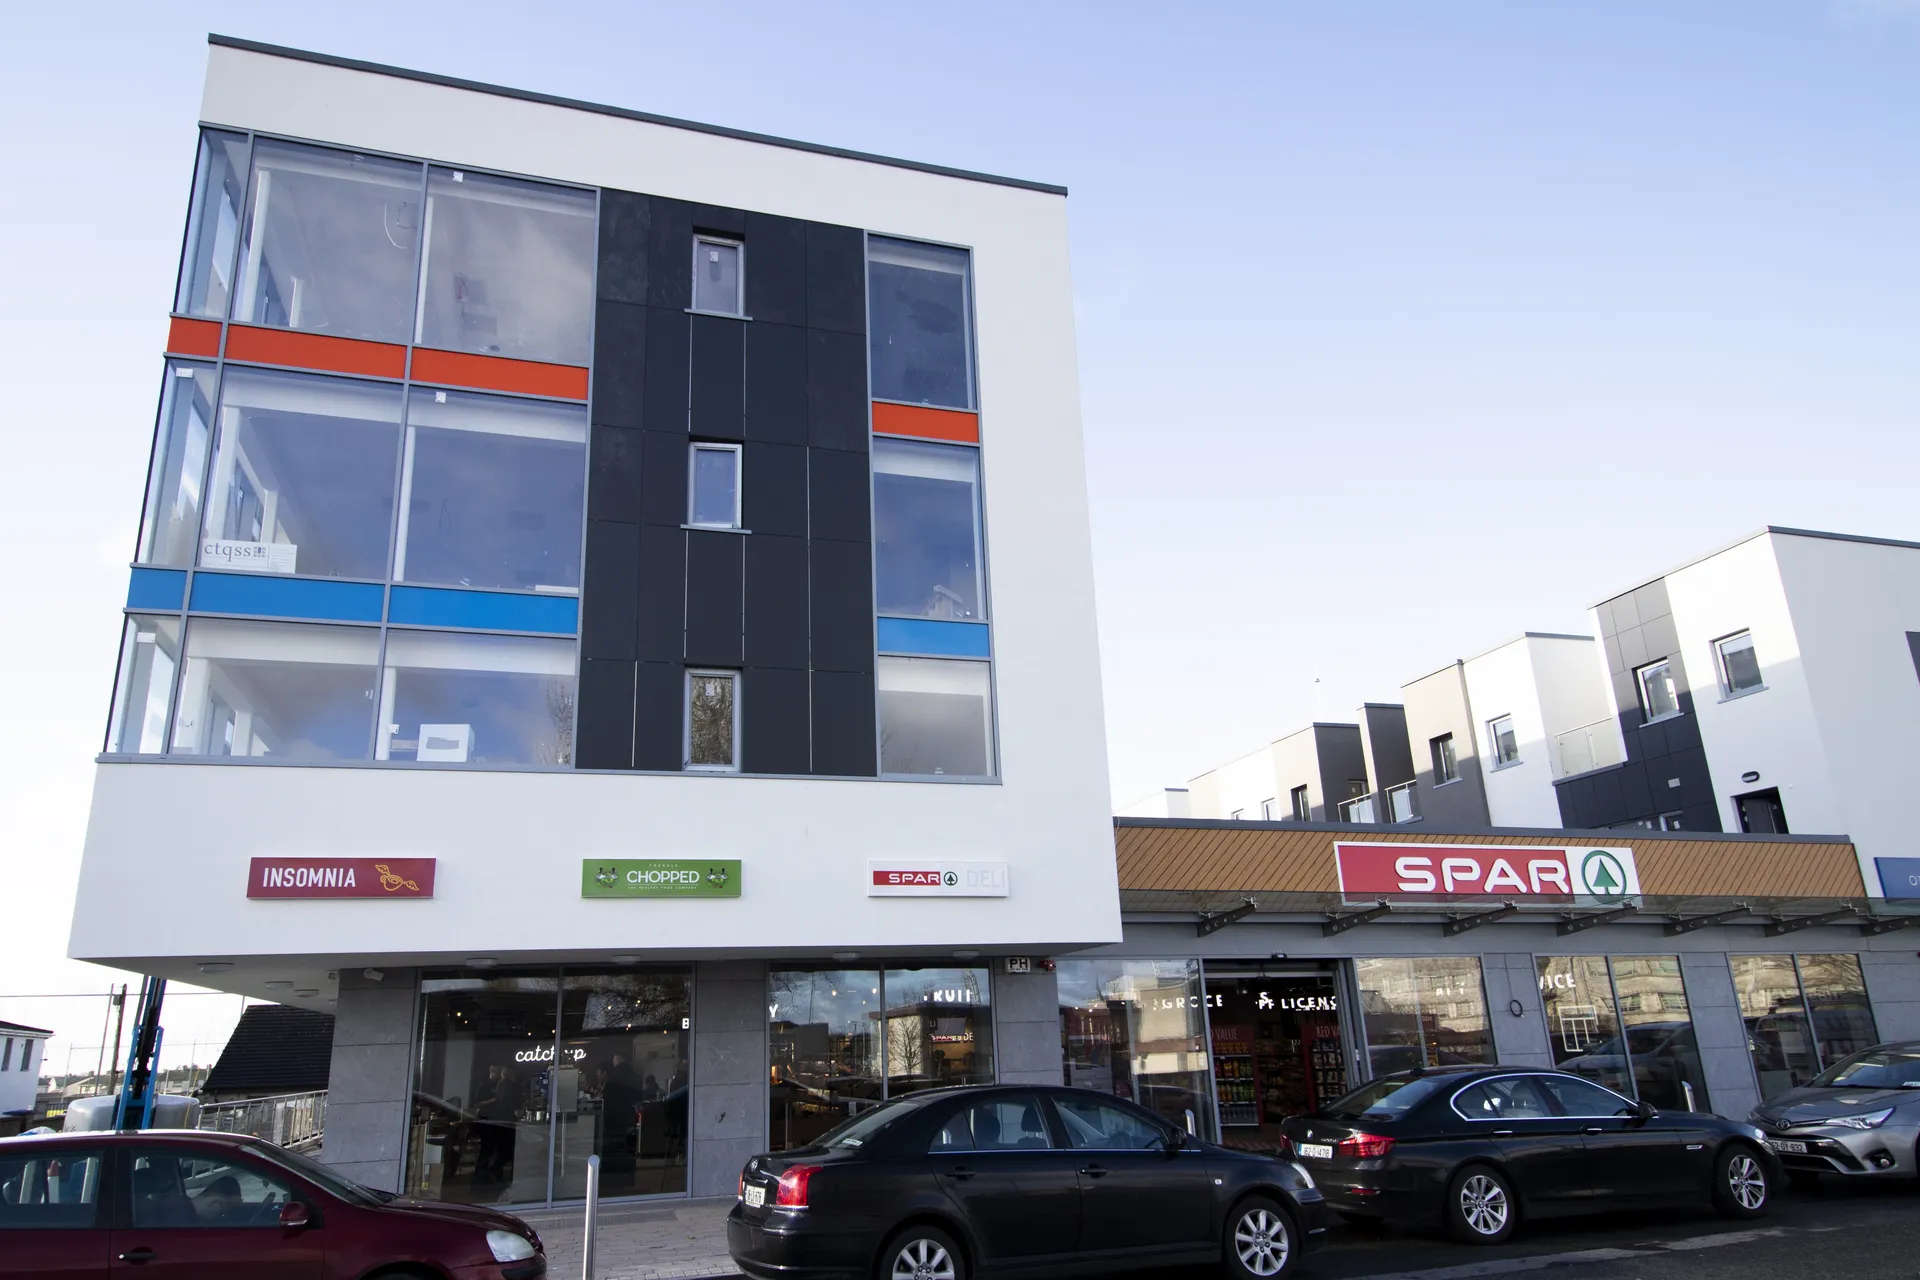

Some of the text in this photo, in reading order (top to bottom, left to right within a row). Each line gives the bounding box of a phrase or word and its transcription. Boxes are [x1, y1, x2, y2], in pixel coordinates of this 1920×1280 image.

[204, 542, 251, 562] ctqss
[262, 867, 357, 888] INSOMNIA
[626, 870, 700, 884] CHOPPED
[888, 870, 1005, 888] SPAR DELI
[1394, 856, 1570, 894] SPAR
[1009, 958, 1028, 969] PH
